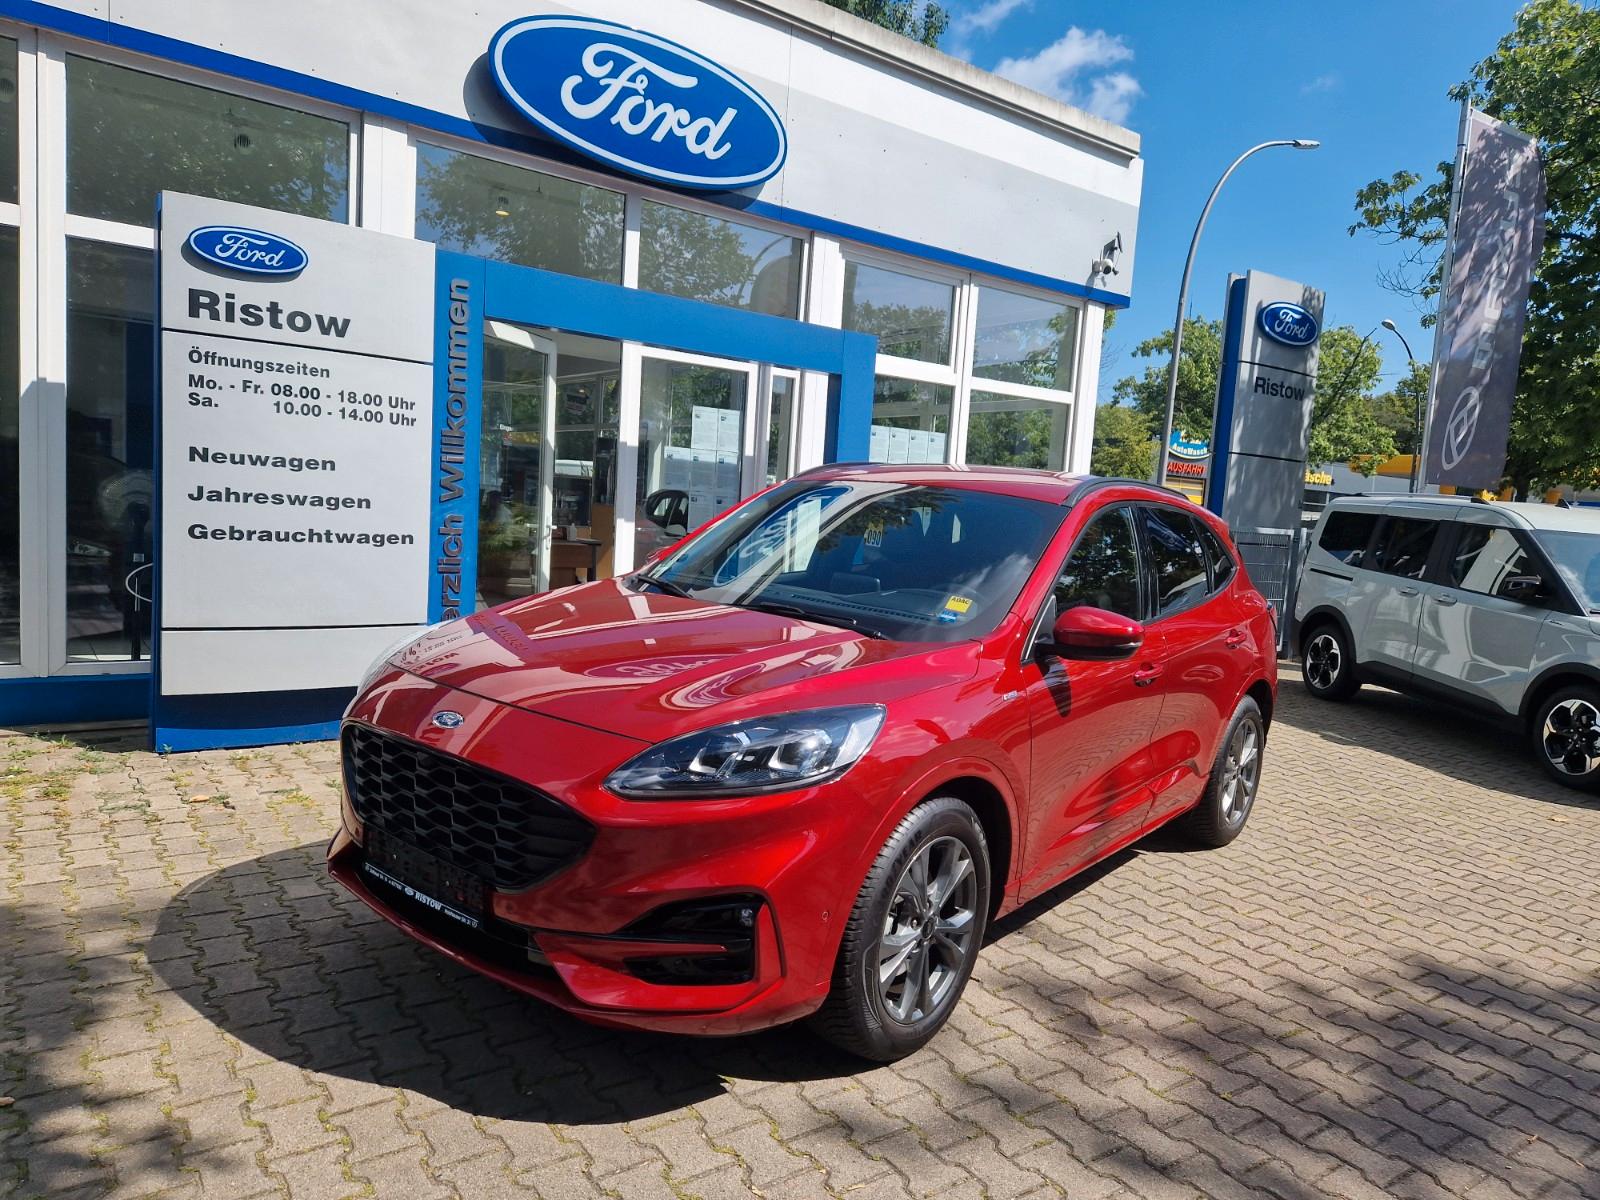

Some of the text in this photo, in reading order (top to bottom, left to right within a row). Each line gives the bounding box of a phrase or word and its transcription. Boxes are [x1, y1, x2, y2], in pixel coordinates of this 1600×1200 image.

[560, 42, 737, 160] Ford
[215, 233, 286, 268] Ford
[188, 288, 351, 338] Ristow
[1274, 309, 1310, 339] Ford
[188, 346, 330, 378] Öffnungszeiten
[188, 374, 223, 390] Mo.
[242, 380, 264, 394] Fr.
[271, 383, 321, 400] 08.00
[338, 390, 383, 406] 18.00
[388, 395, 416, 410] Uhr
[439, 278, 470, 503] Willkommen
[1254, 376, 1305, 402] Ristow
[188, 392, 219, 407] Sa.
[273, 400, 322, 417] 10.00
[339, 407, 384, 423] 14.00
[389, 412, 417, 427] Uhr
[188, 446, 336, 472] Neuwagen
[187, 485, 371, 511] Jahreswagen
[187, 523, 415, 548] Gebrauchtwagen
[414, 891, 442, 911] RISTOW
